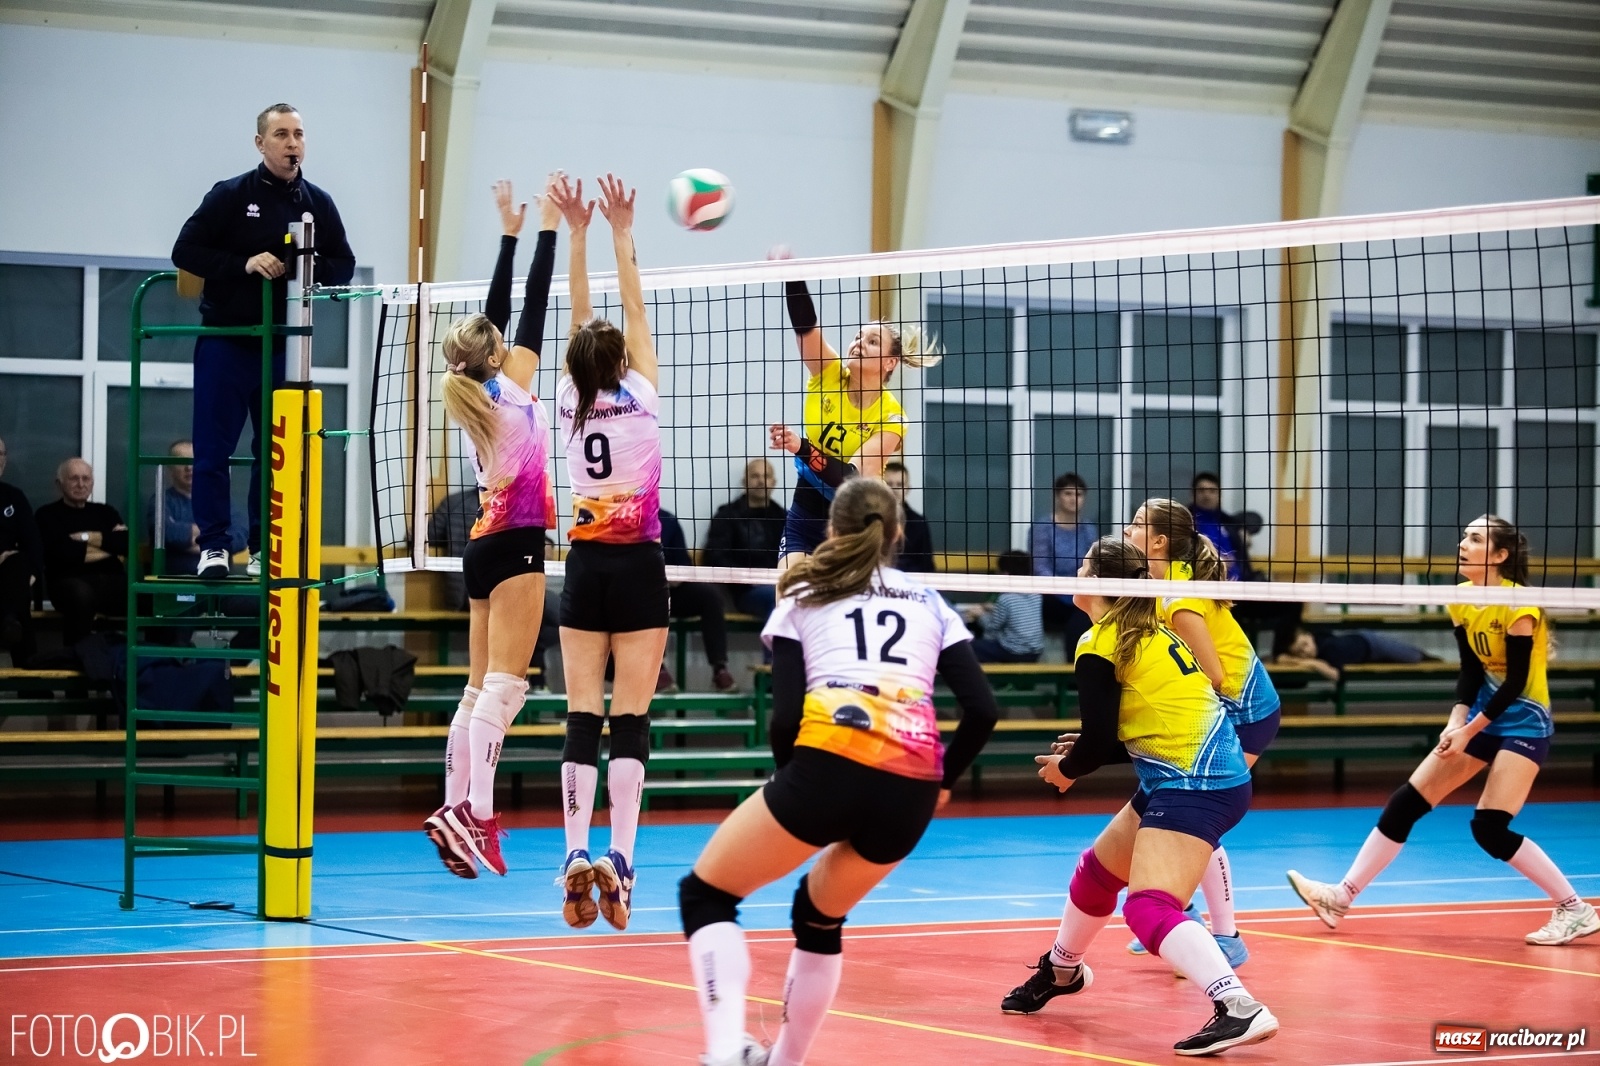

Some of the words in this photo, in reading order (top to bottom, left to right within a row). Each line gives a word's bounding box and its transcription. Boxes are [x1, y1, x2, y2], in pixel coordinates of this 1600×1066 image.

[818, 421, 847, 454] 12
[583, 432, 613, 480] 9
[844, 607, 908, 666] 12
[1473, 631, 1492, 657] 10
[1207, 980, 1232, 998] gala
